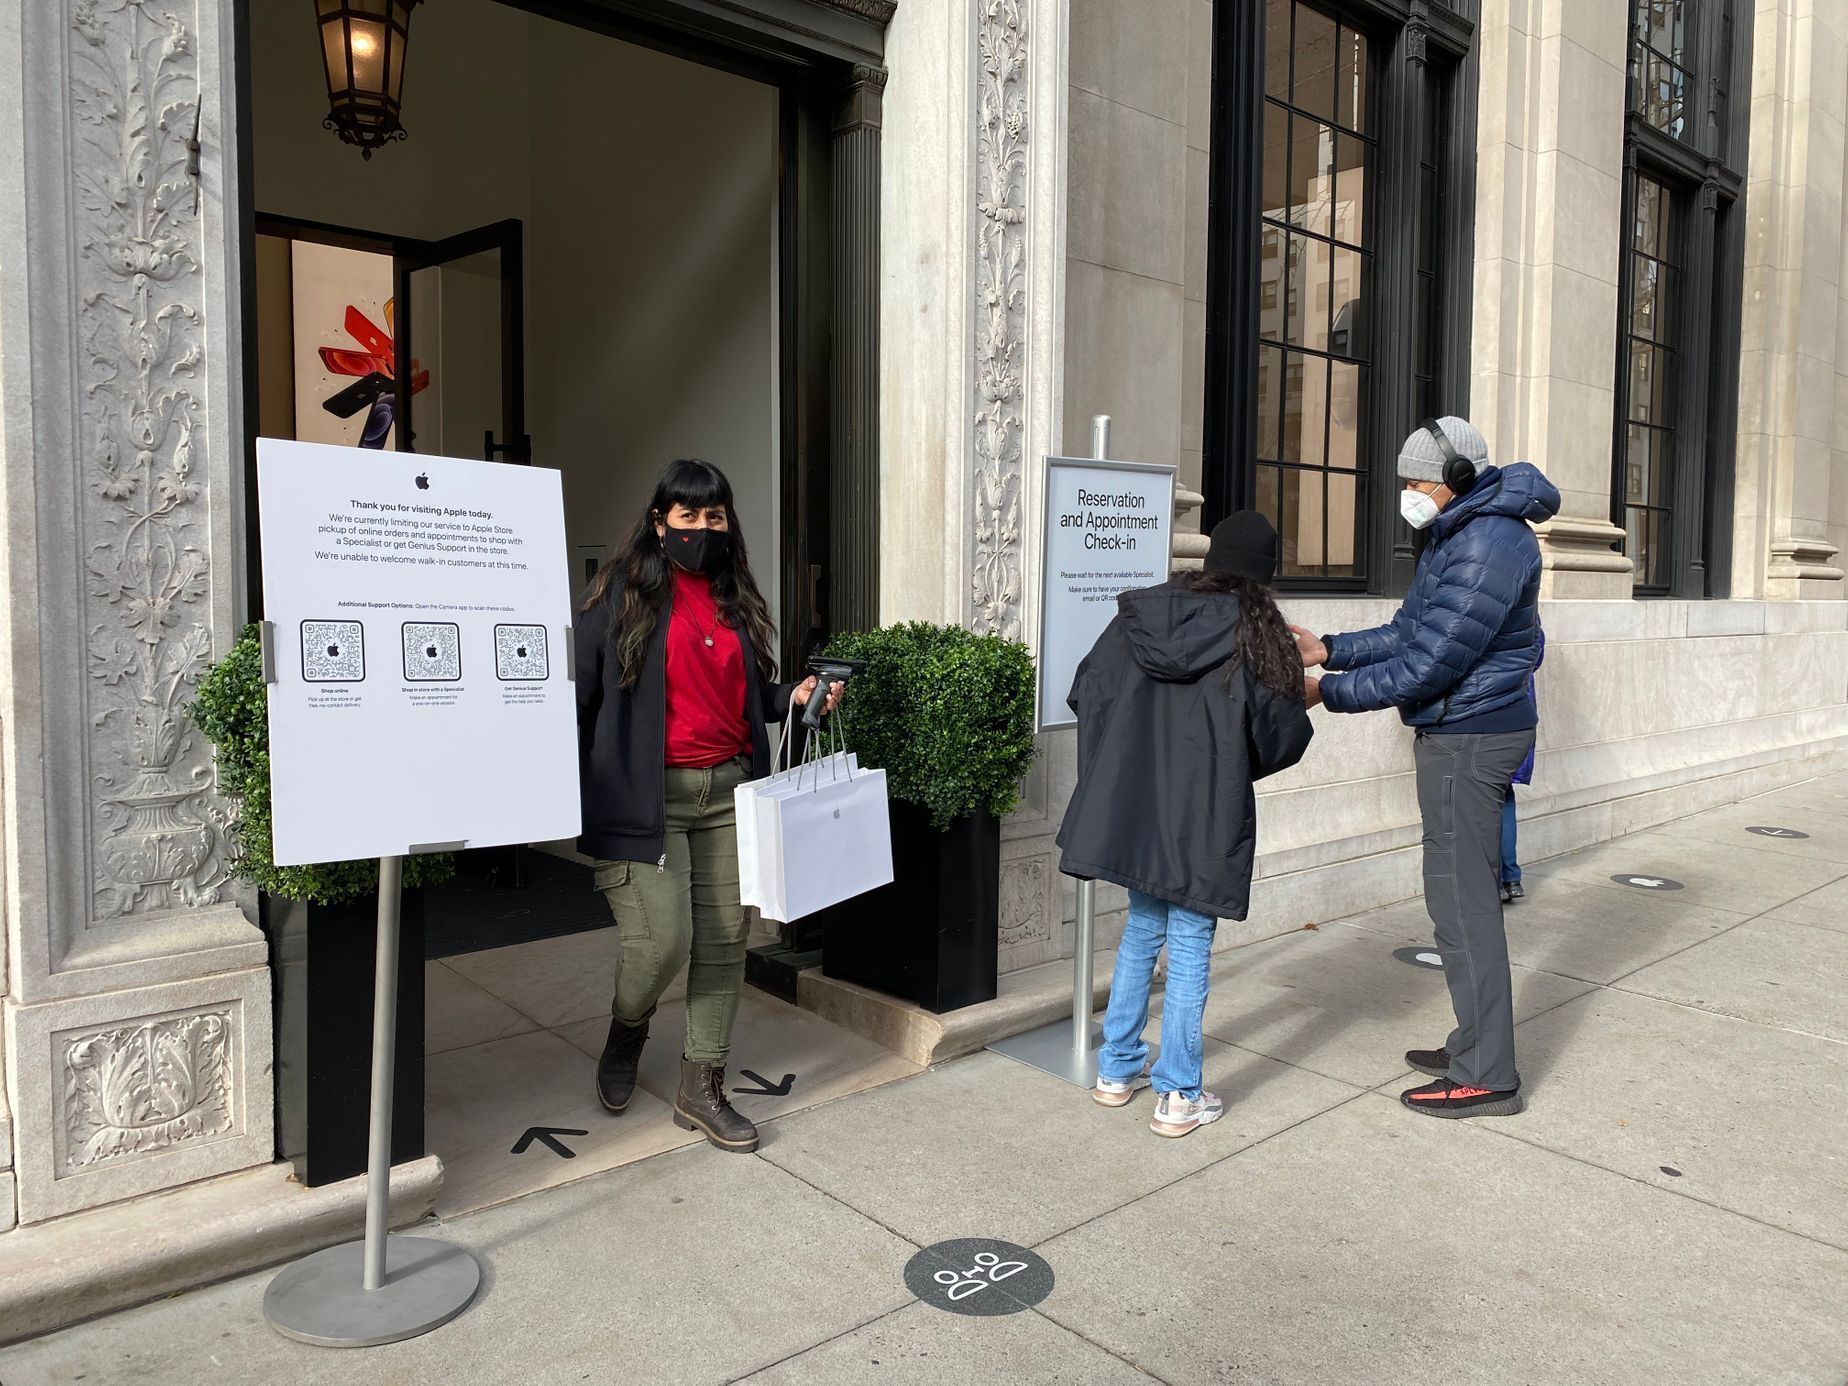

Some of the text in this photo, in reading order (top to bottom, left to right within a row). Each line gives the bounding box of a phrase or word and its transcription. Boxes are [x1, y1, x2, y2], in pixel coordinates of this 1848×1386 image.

[1078, 489, 1145, 508] Reservation
[350, 500, 493, 520] Thank you for visiting Apple today.
[328, 513, 352, 523] We're
[354, 517, 389, 527] currently
[391, 518, 419, 529] limiting
[434, 521, 461, 531] service
[463, 523, 470, 531] to
[472, 524, 492, 533] Apple
[494, 526, 513, 535] Store
[1060, 511, 1158, 531] and Appointment
[318, 524, 523, 546] pickup of online orders and appointments to shop with
[1084, 533, 1136, 550] Check-in
[343, 537, 382, 547] Specialist
[393, 540, 407, 550] get
[408, 541, 435, 550] Genius
[436, 543, 467, 553] Support
[468, 545, 475, 553] in
[476, 545, 488, 554] the
[490, 547, 510, 555] store.
[314, 551, 529, 570] We're unable to welcome walk-in customers at this time.
[1061, 571, 1076, 579] Please
[1101, 594, 1108, 602] QR
